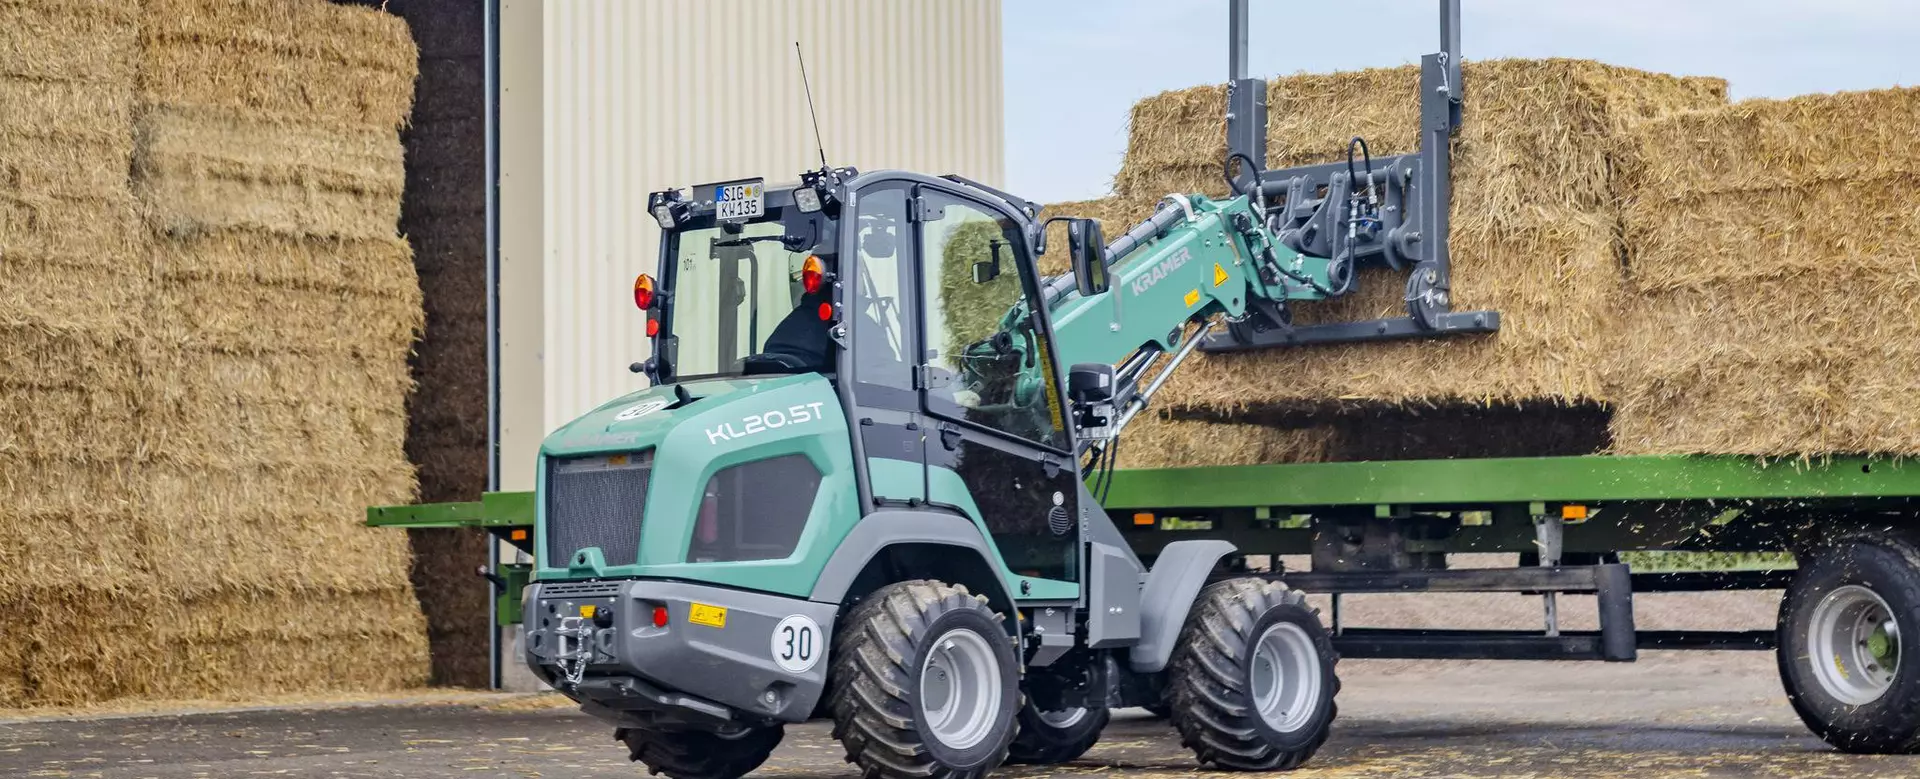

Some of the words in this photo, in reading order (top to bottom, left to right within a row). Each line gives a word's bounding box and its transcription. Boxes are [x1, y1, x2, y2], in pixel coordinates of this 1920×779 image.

[724, 186, 743, 201] SIG
[1131, 246, 1193, 296] KRAMER
[705, 402, 824, 445] KL20.5T
[781, 625, 812, 661] 30
